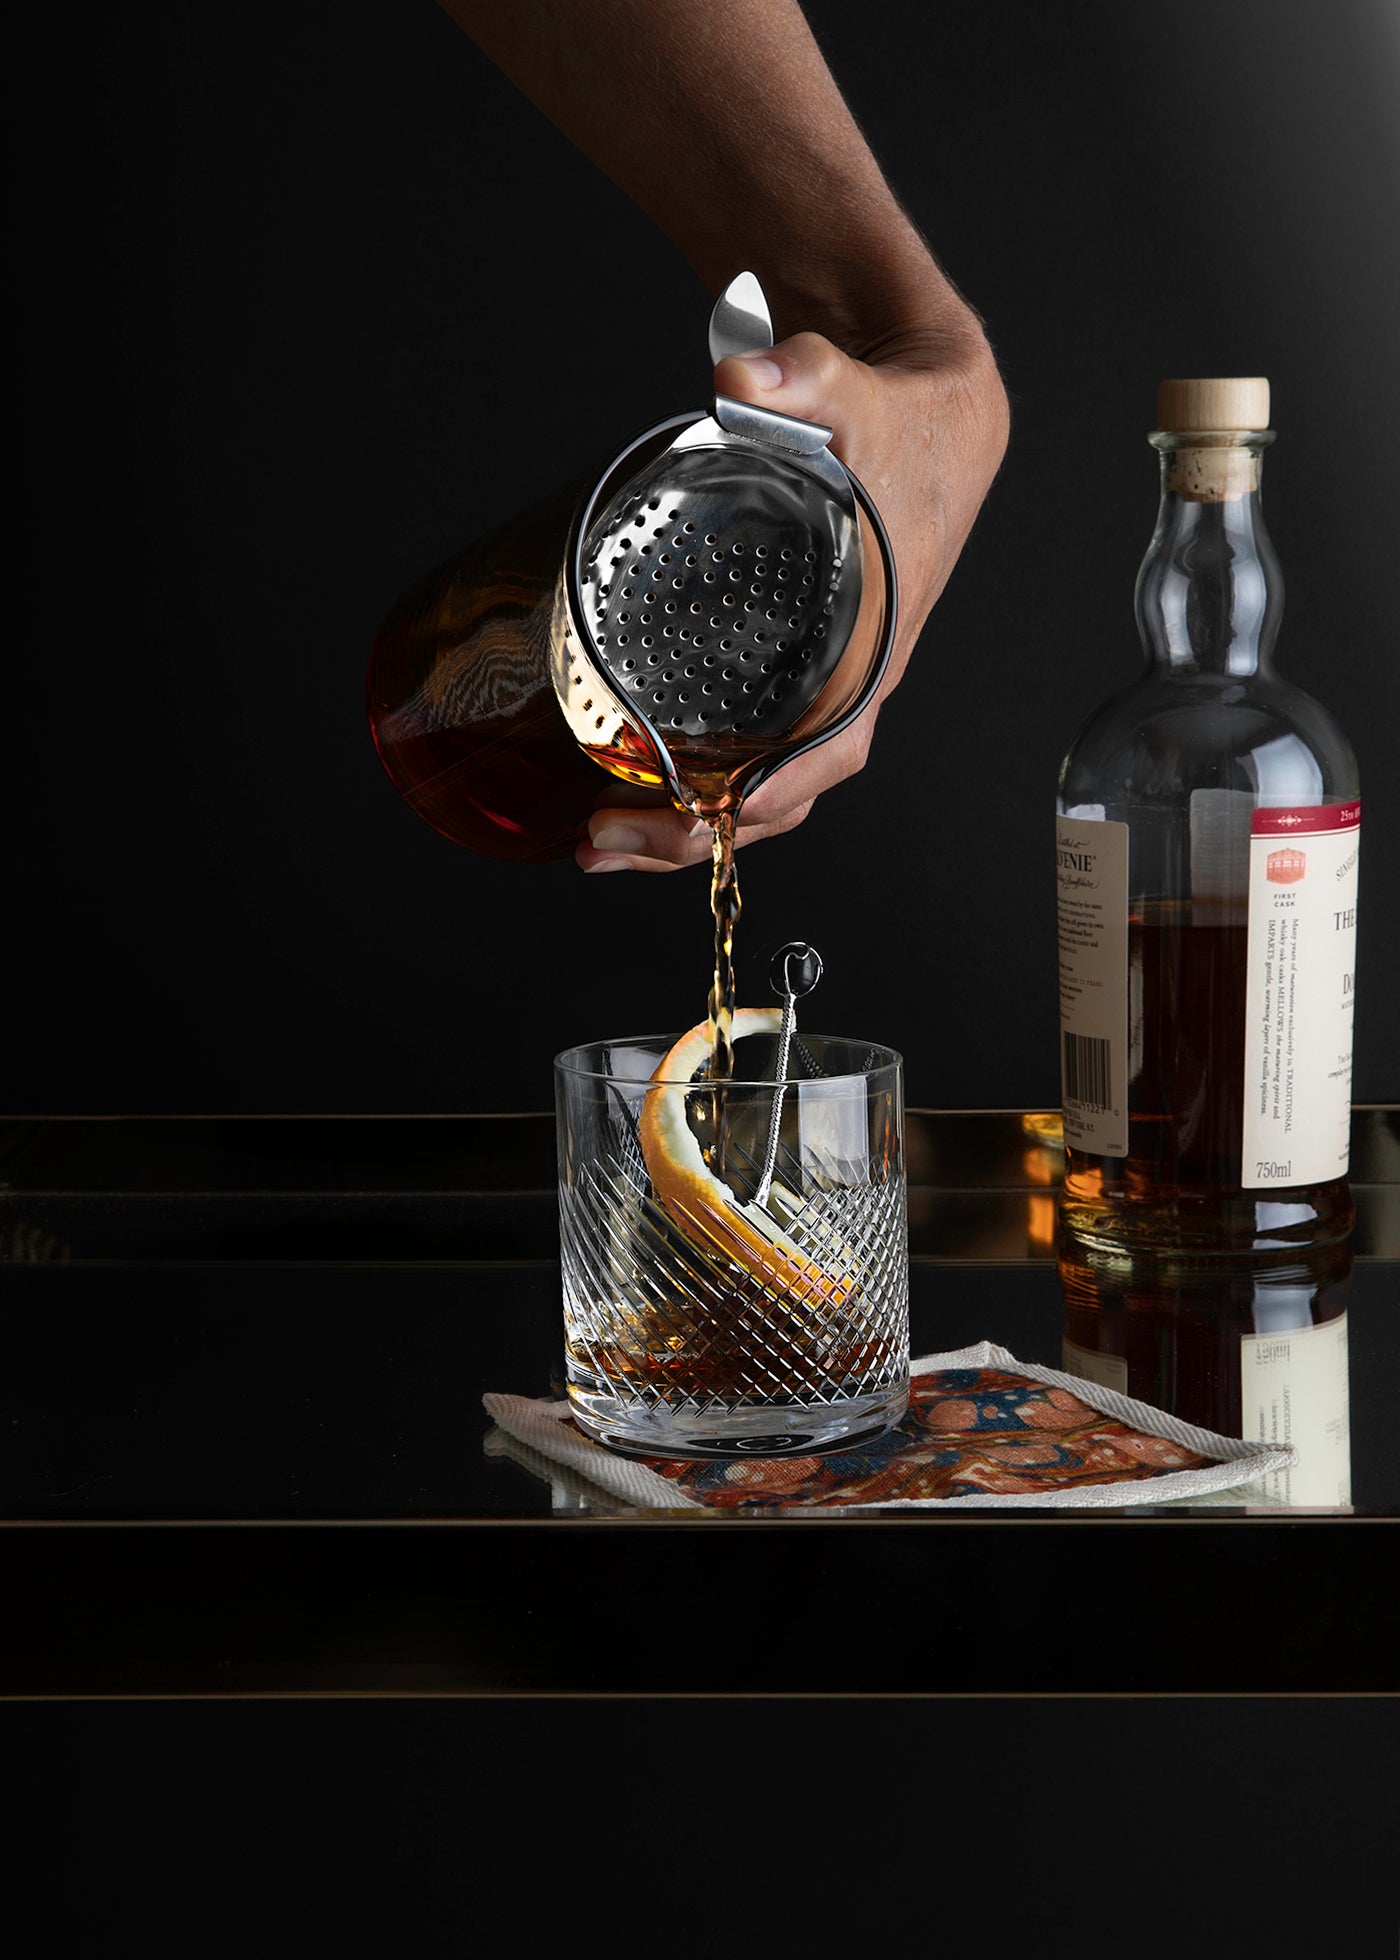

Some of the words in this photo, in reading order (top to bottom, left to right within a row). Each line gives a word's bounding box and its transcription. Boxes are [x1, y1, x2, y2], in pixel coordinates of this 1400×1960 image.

[1290, 918, 1300, 940] Many
[1334, 908, 1355, 931] THE
[1268, 919, 1276, 960] IMPARTS
[1279, 919, 1288, 945] whisky
[1279, 947, 1288, 962] oak
[1278, 964, 1286, 984] casks
[1290, 962, 1298, 972] of
[1262, 989, 1271, 1023] warming
[1277, 986, 1285, 1032] MELLOWS
[1262, 1024, 1272, 1045] layers
[1275, 1034, 1283, 1046] the
[1286, 1015, 1295, 1056] exclusively
[1263, 1046, 1272, 1055] of
[1262, 1056, 1271, 1080] vanilla
[1273, 1048, 1281, 1082] maturing
[1287, 1058, 1294, 1066] in
[1272, 1084, 1280, 1104] spirit
[1285, 1068, 1294, 1134] TRADITIONAL
[1273, 1105, 1281, 1119] and
[1256, 1160, 1292, 1179] 750ml
